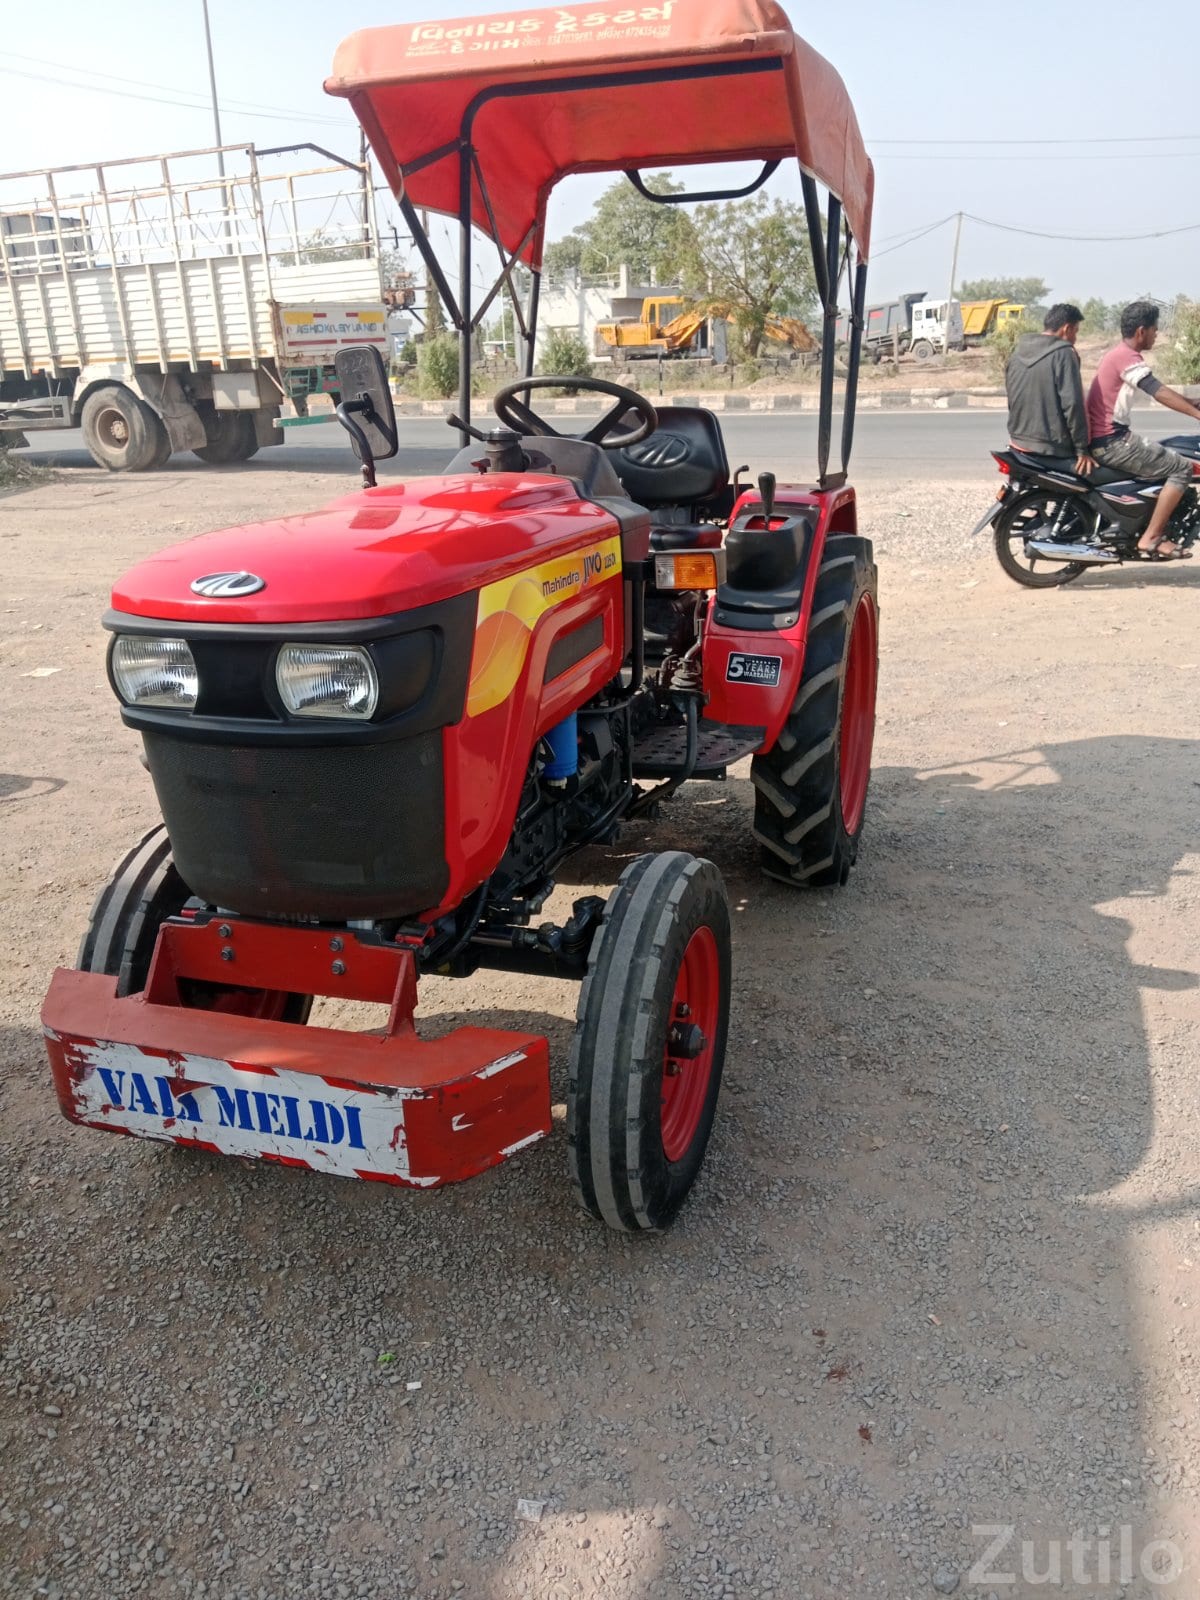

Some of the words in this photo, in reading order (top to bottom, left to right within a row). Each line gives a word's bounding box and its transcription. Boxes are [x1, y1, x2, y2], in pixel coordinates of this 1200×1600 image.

[410, 18, 545, 43] વિનાયક
[542, 571, 580, 597] Mahindra
[727, 656, 745, 678] 5
[745, 662, 777, 674] YEARS
[743, 671, 777, 680] WARRANTY
[210, 1085, 367, 1150] MELDI
